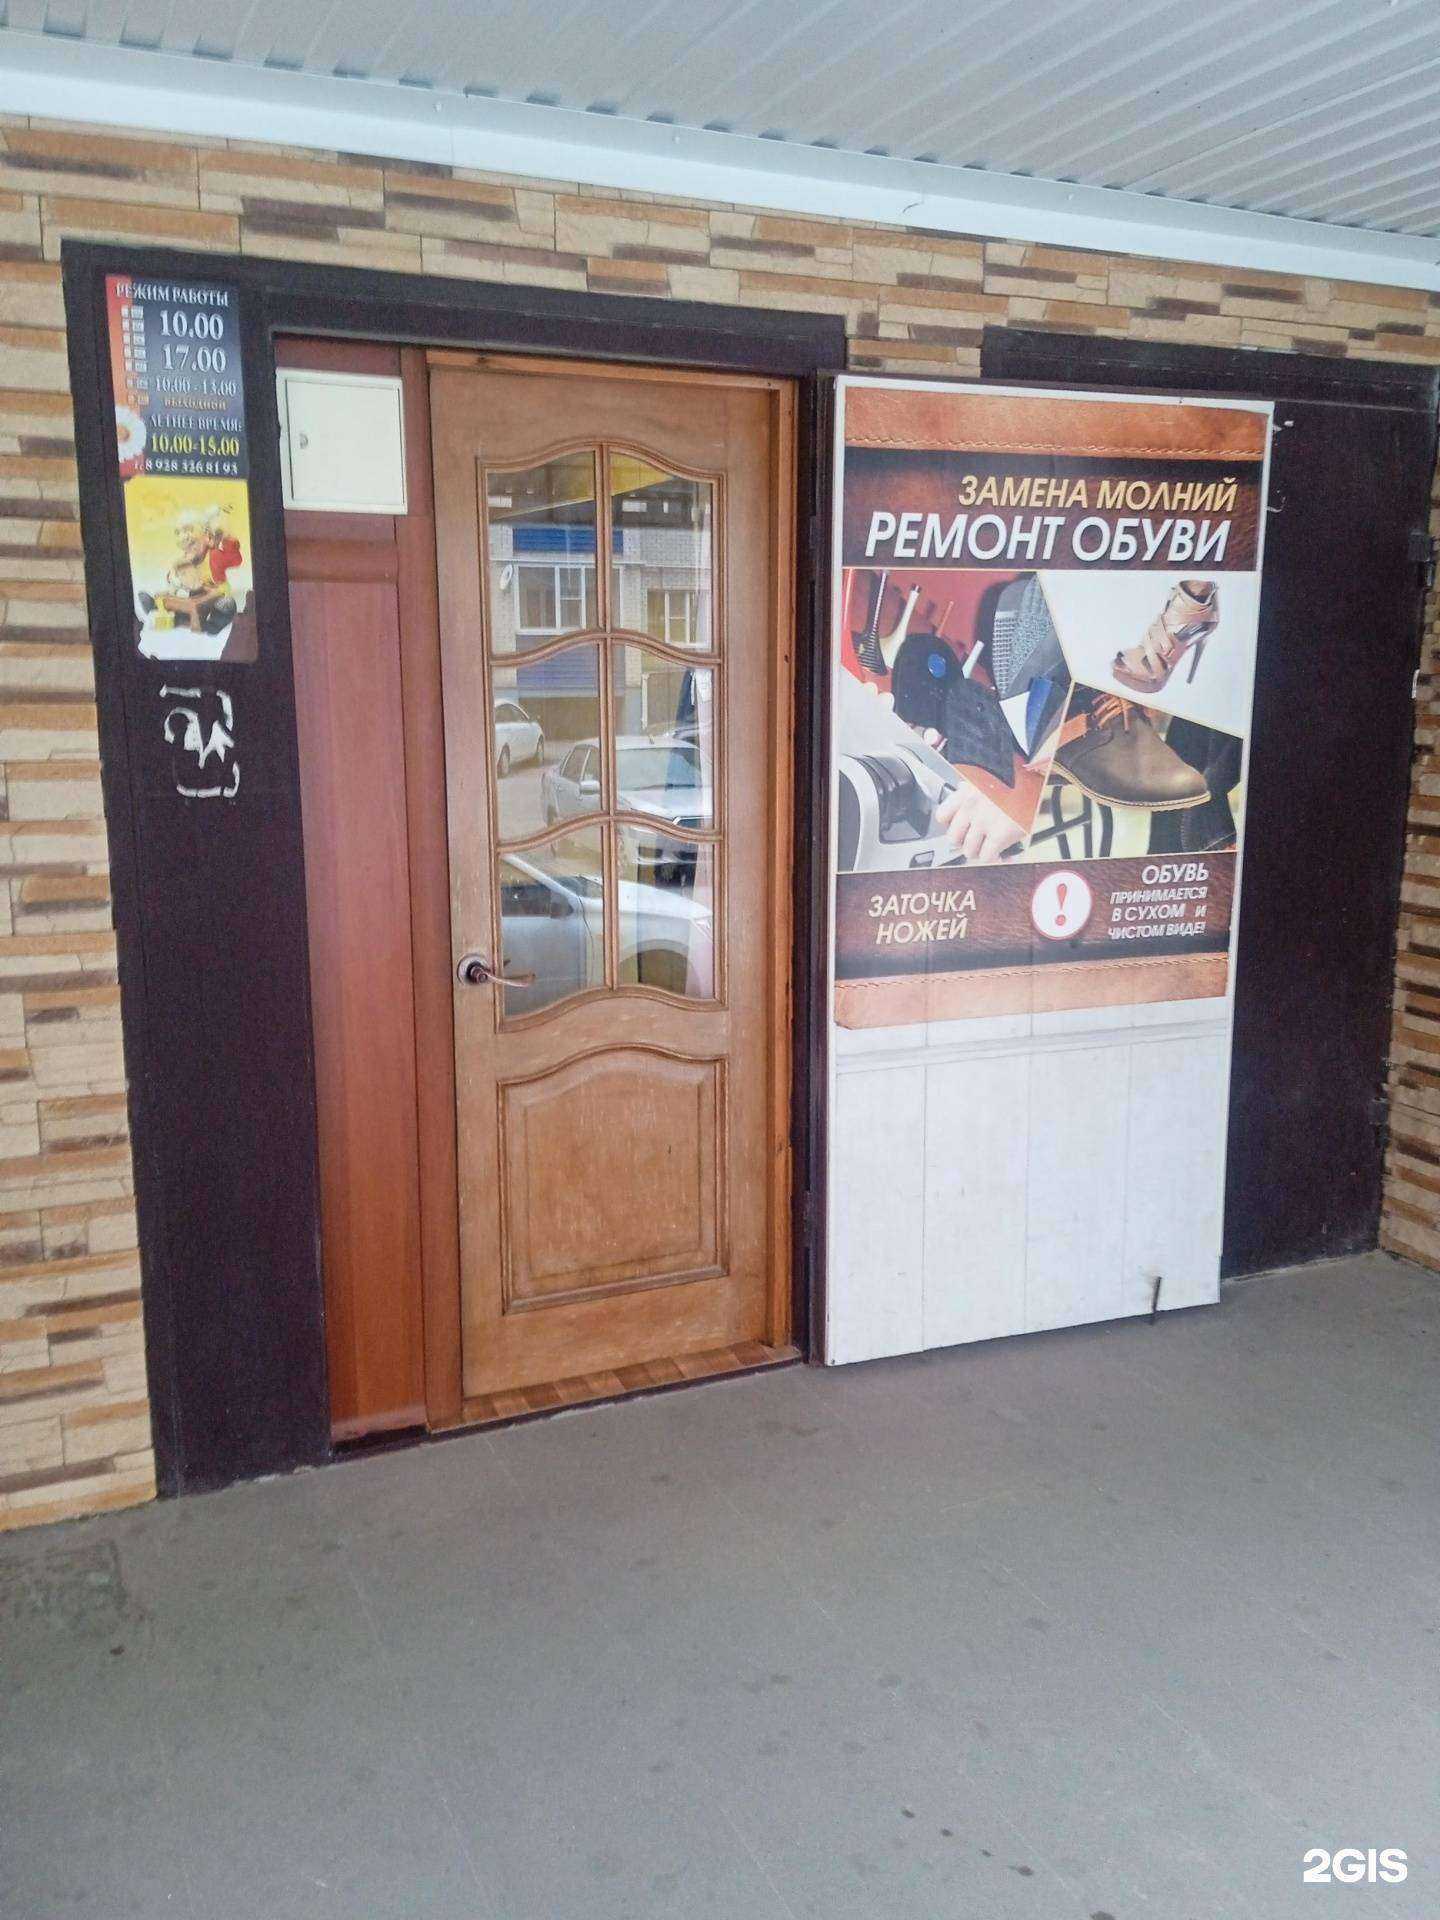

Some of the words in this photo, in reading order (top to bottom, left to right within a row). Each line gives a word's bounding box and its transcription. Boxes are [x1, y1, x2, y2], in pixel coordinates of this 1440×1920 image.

[160, 309, 224, 341] 10.00
[162, 343, 227, 373] 17.00
[958, 475, 1089, 510] ЗАМЕНА
[1096, 477, 1238, 513] МОЛНИЙ
[864, 511, 1066, 560] РЕМОНТ
[1071, 516, 1232, 563] ОБУВИ
[1141, 862, 1210, 885] ОБУВЬ
[868, 889, 977, 918] ЗАТОЧКА
[1109, 886, 1208, 905] ПРИНИМАЕТСЯ
[1111, 907, 1122, 922] В
[1124, 903, 1186, 921] СУХОМ
[1194, 904, 1207, 918] И
[875, 912, 969, 945] НОЖЕЙ
[1107, 924, 1166, 940] ЧИСТОМ
